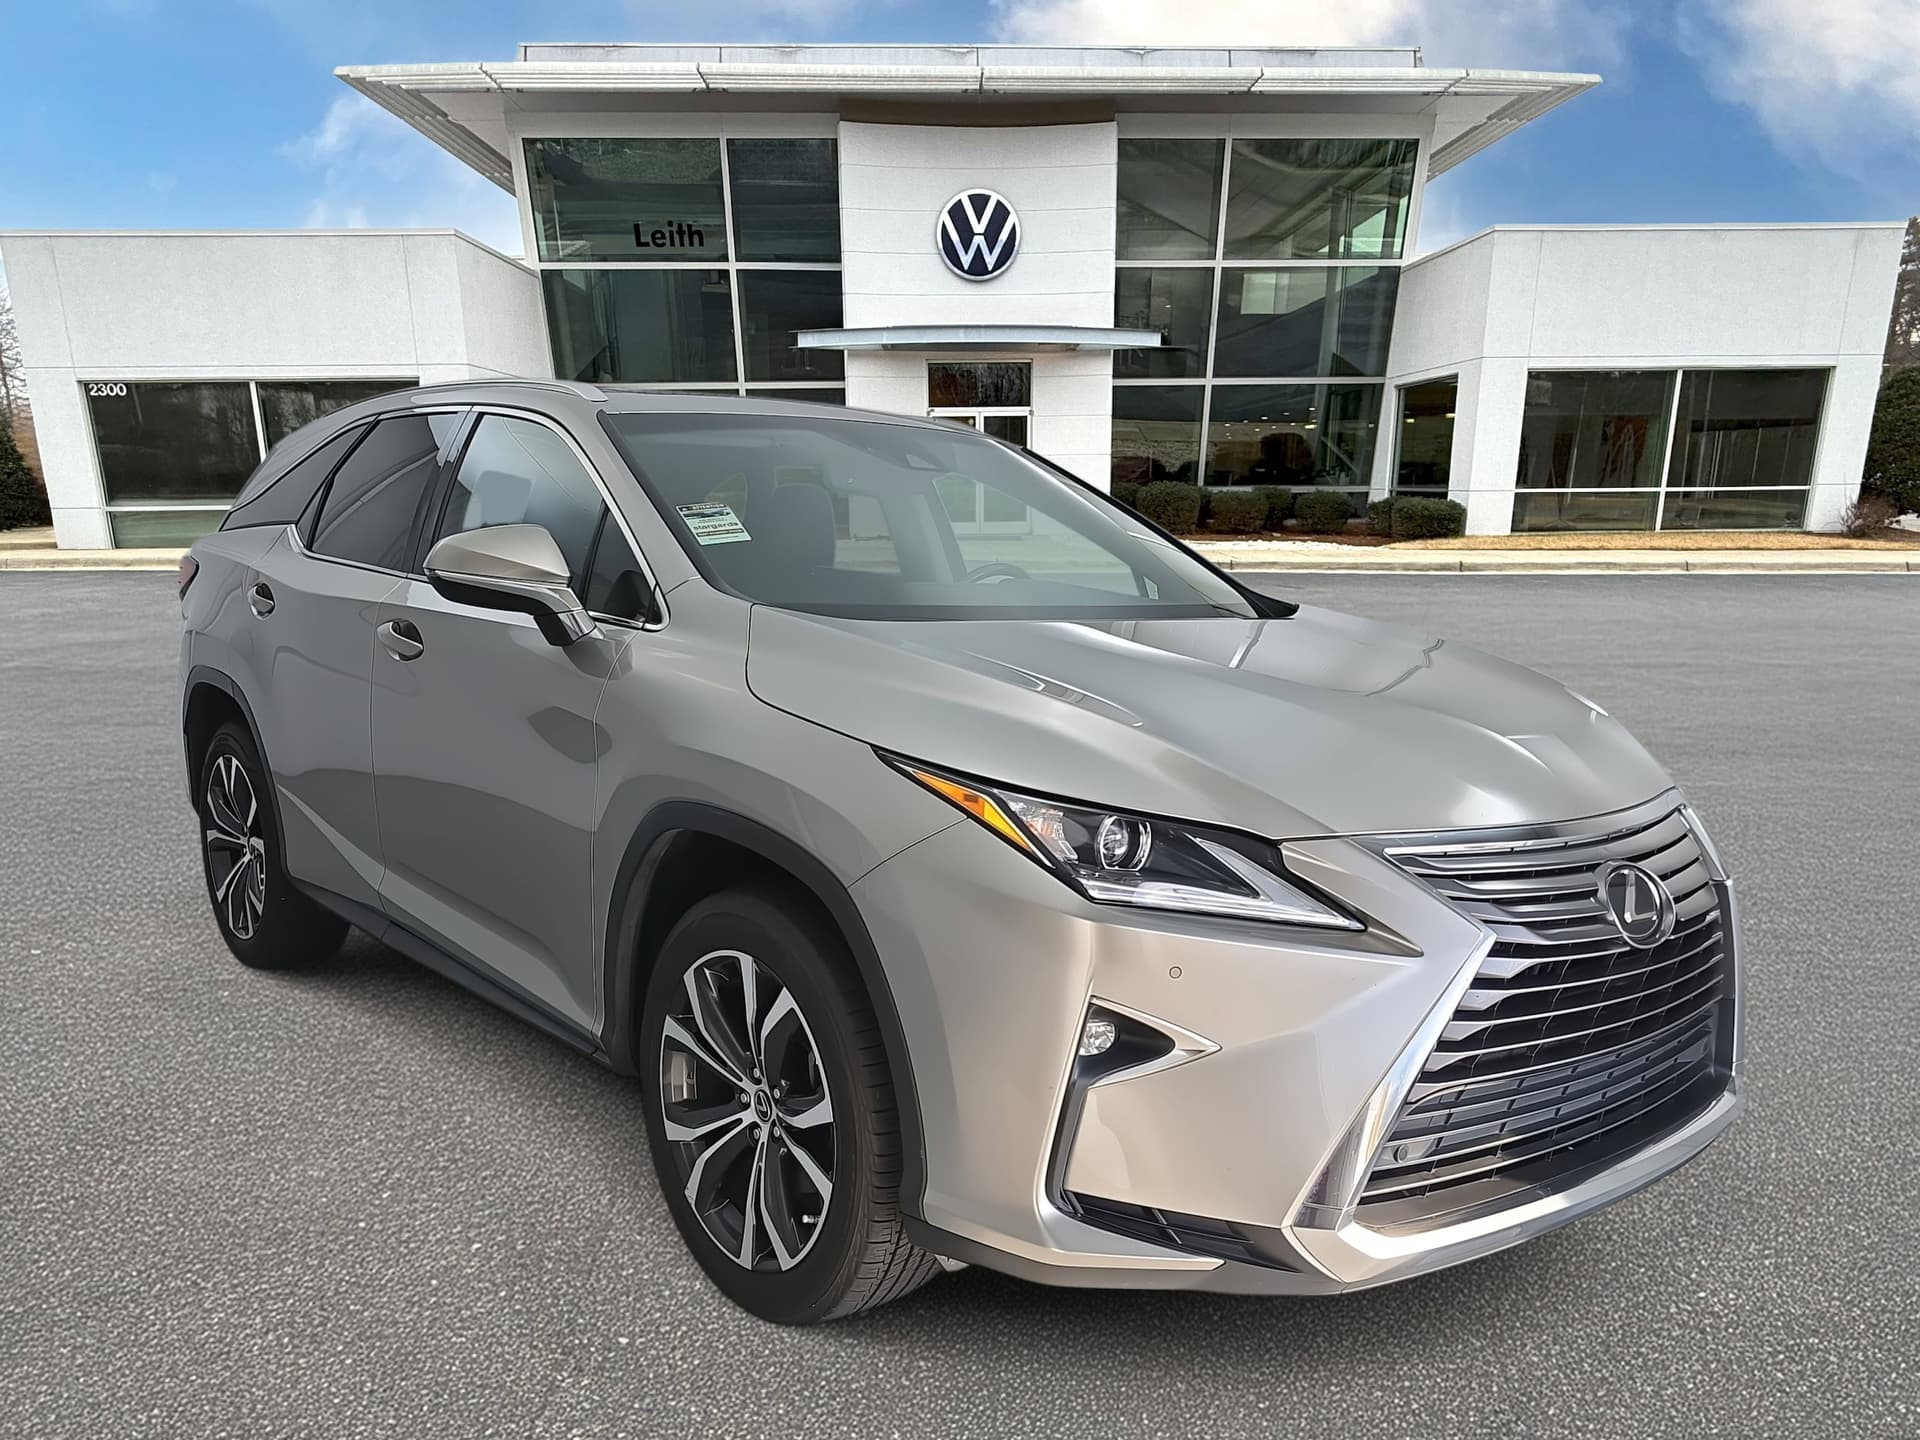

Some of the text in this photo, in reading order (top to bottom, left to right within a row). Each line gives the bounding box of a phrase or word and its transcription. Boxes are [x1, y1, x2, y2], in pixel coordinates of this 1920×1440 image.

[633, 220, 704, 247] Leith
[940, 190, 1018, 272] VW
[88, 383, 127, 396] 2300
